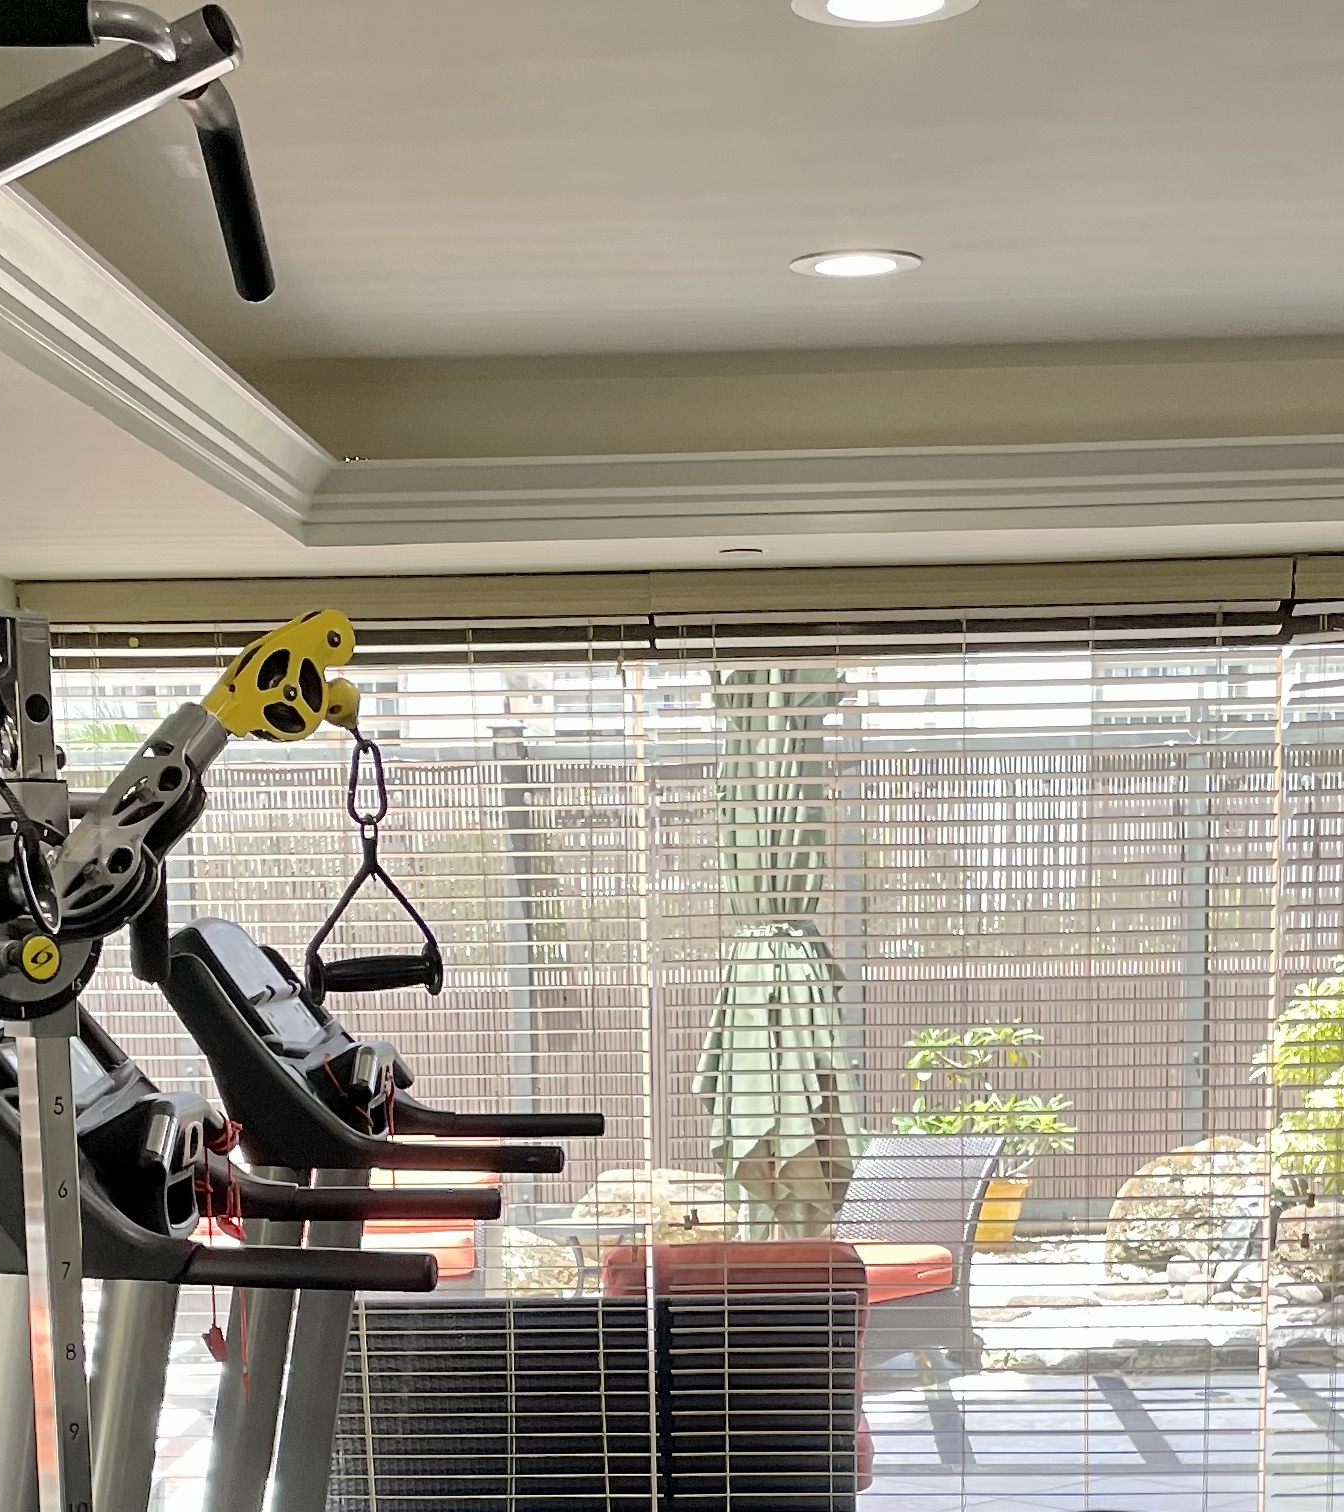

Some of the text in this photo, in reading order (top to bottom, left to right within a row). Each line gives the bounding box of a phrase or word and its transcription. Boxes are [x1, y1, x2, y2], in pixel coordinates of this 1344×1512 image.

[53, 1096, 65, 1116] 5
[58, 1179, 68, 1199] 6
[60, 1260, 71, 1281] 7
[66, 1343, 77, 1361] 8
[68, 1422, 80, 1441] 9
